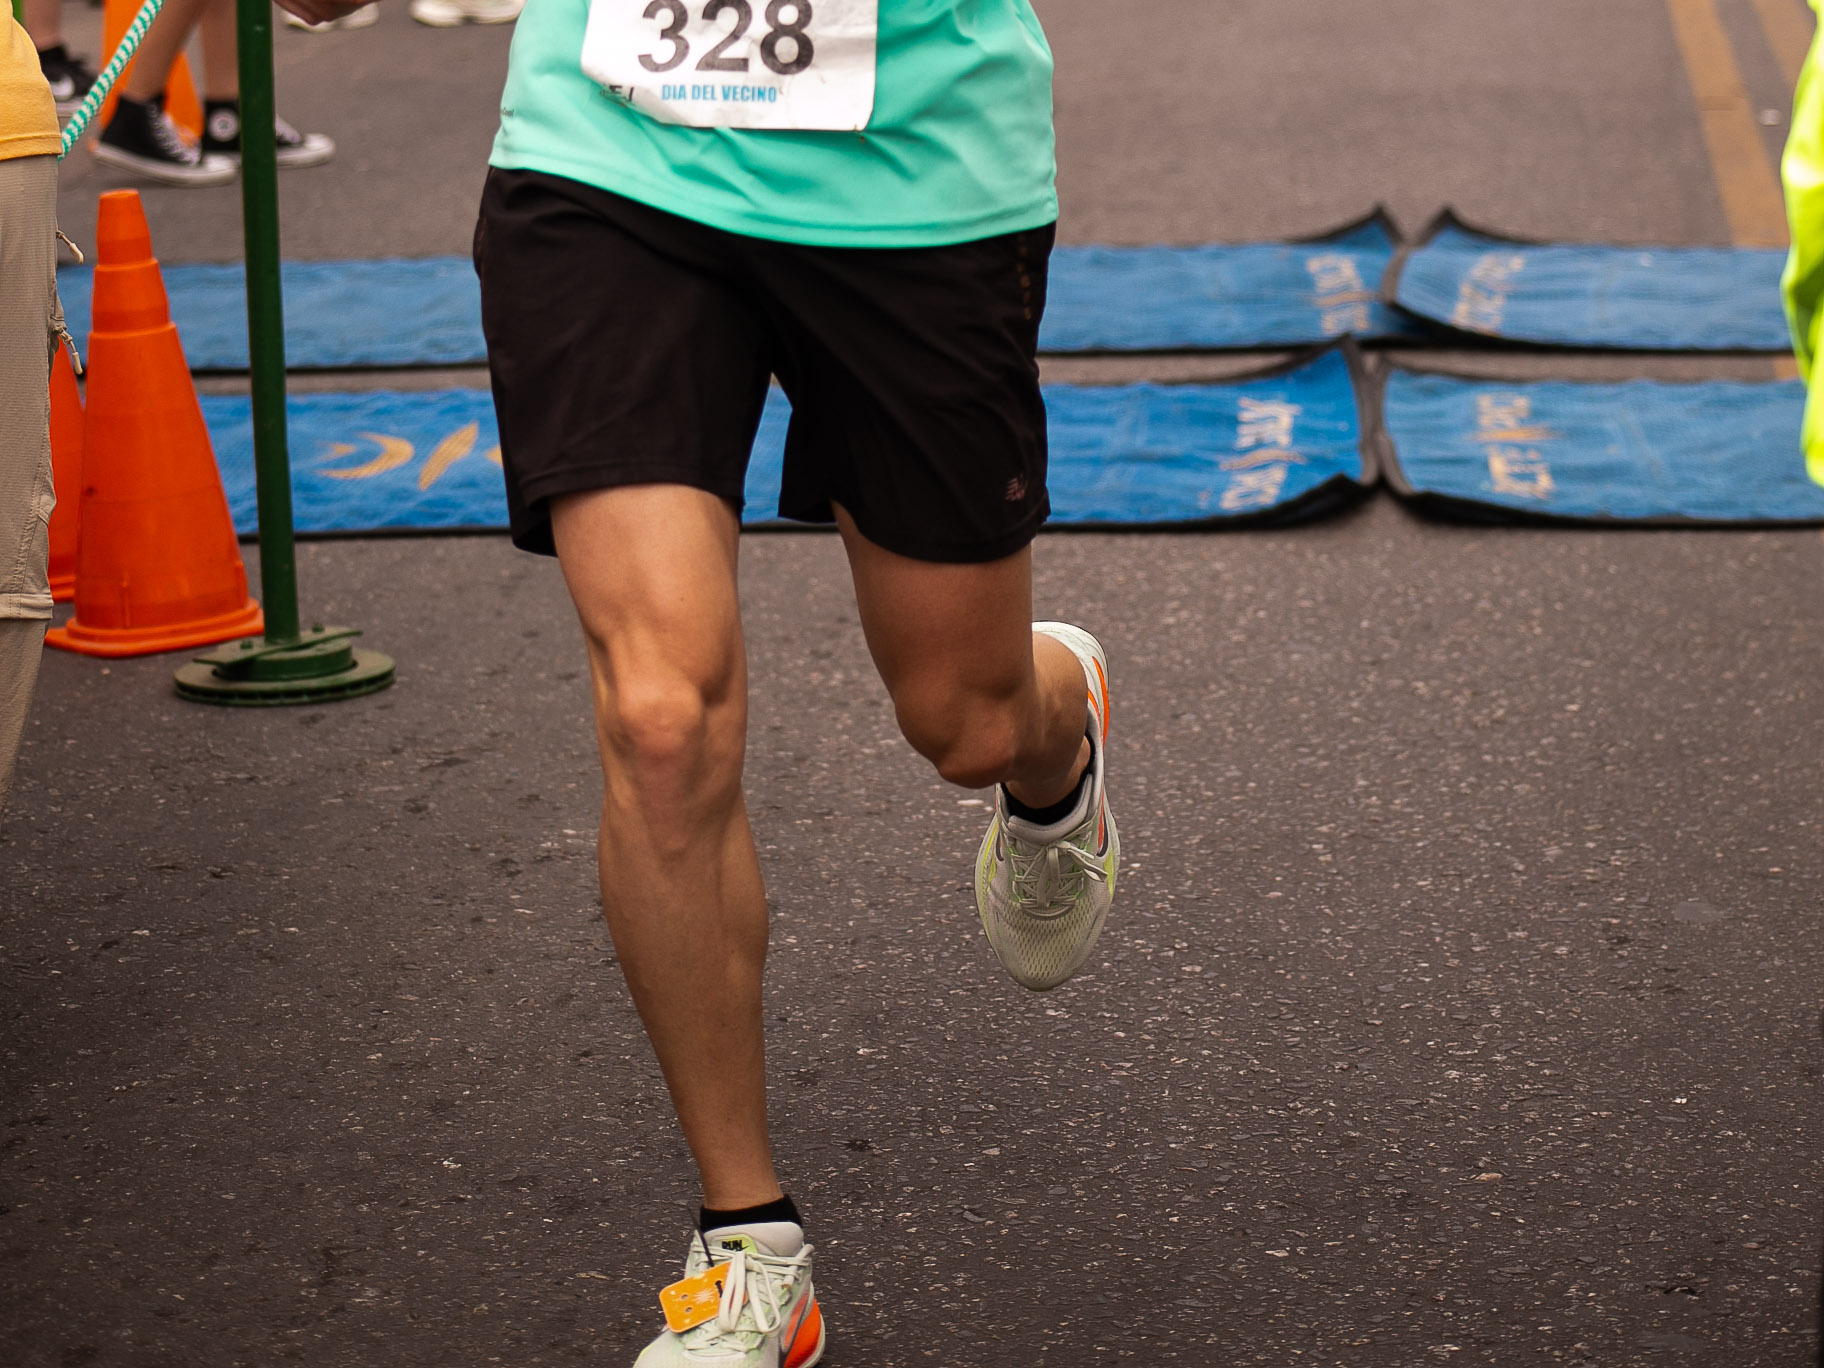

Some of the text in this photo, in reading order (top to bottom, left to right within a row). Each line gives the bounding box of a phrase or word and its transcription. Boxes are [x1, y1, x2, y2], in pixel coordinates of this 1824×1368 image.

[662, 84, 777, 103] DIA DEL VECINO
